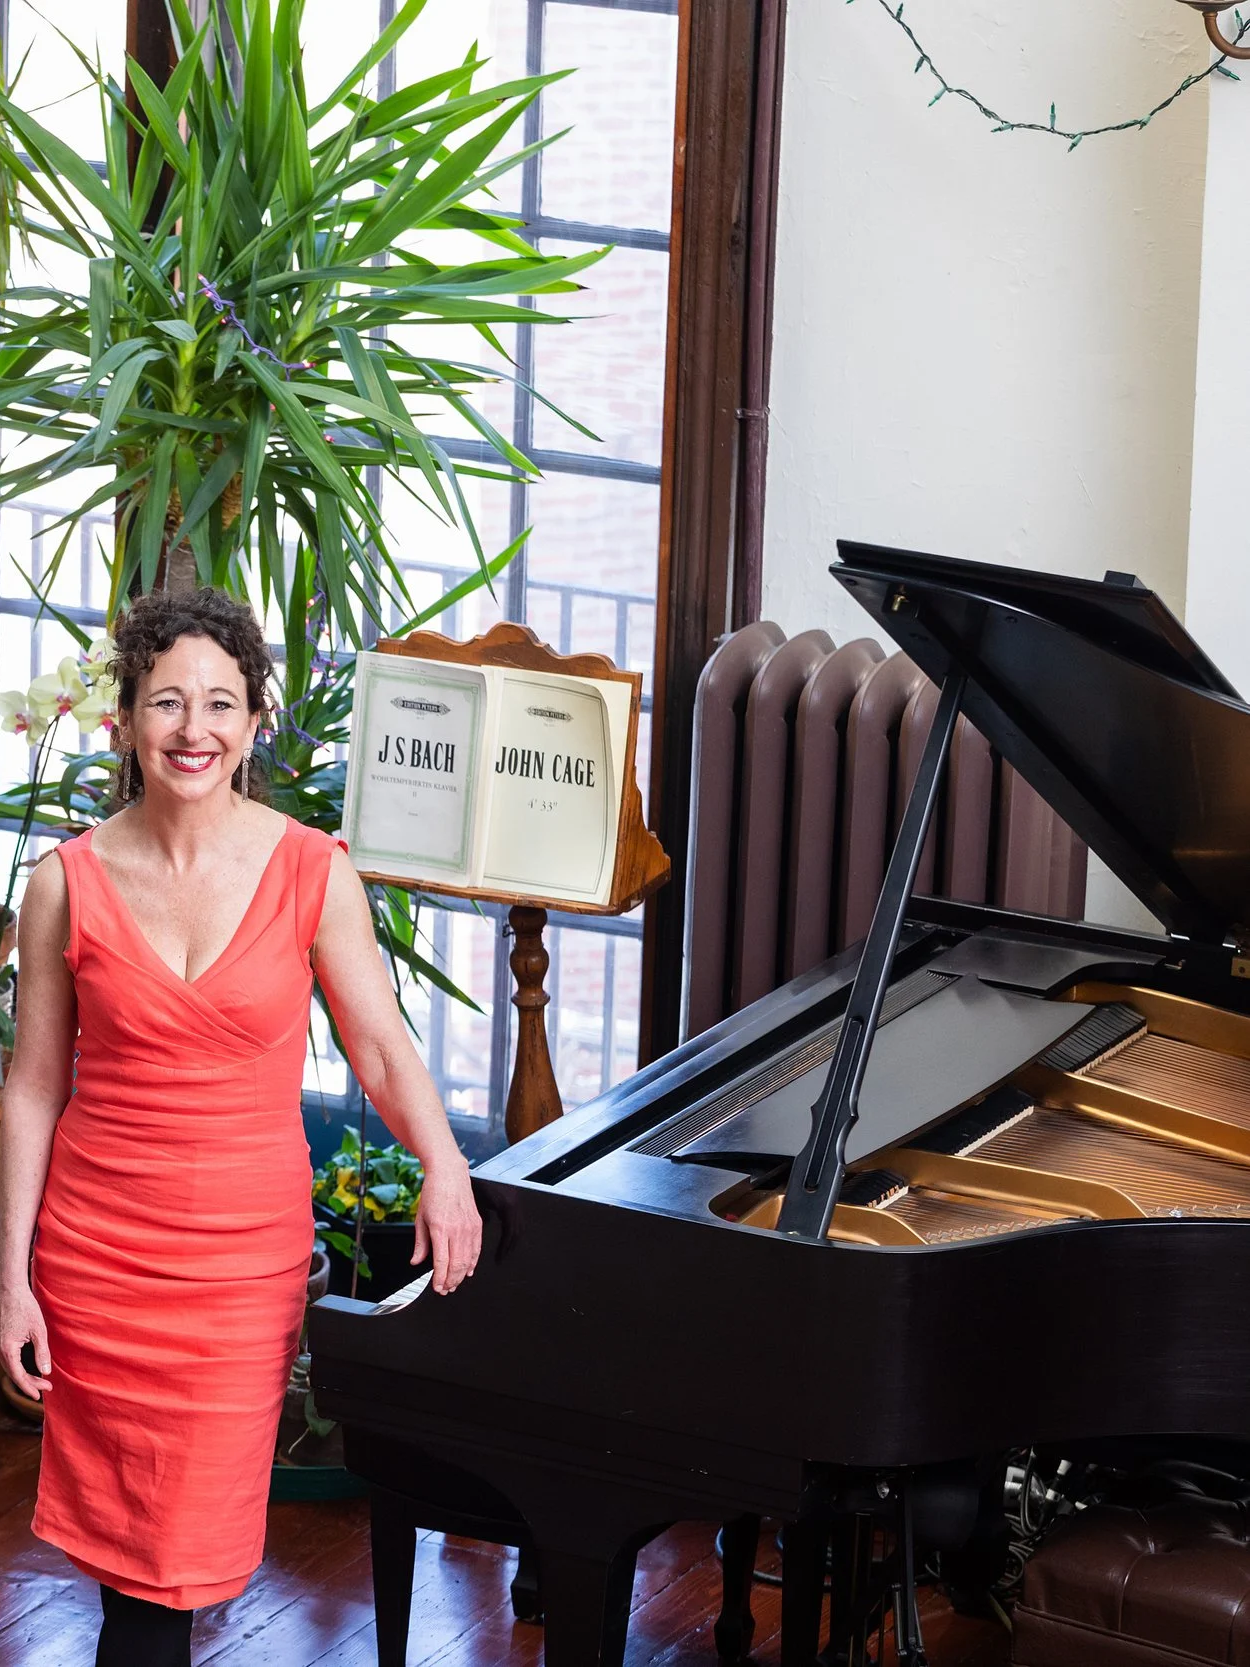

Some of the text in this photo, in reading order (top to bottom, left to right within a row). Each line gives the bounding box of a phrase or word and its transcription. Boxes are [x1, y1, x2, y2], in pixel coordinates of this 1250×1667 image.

[410, 738, 456, 773] BACH
[495, 746, 596, 788] JOHN CAGE
